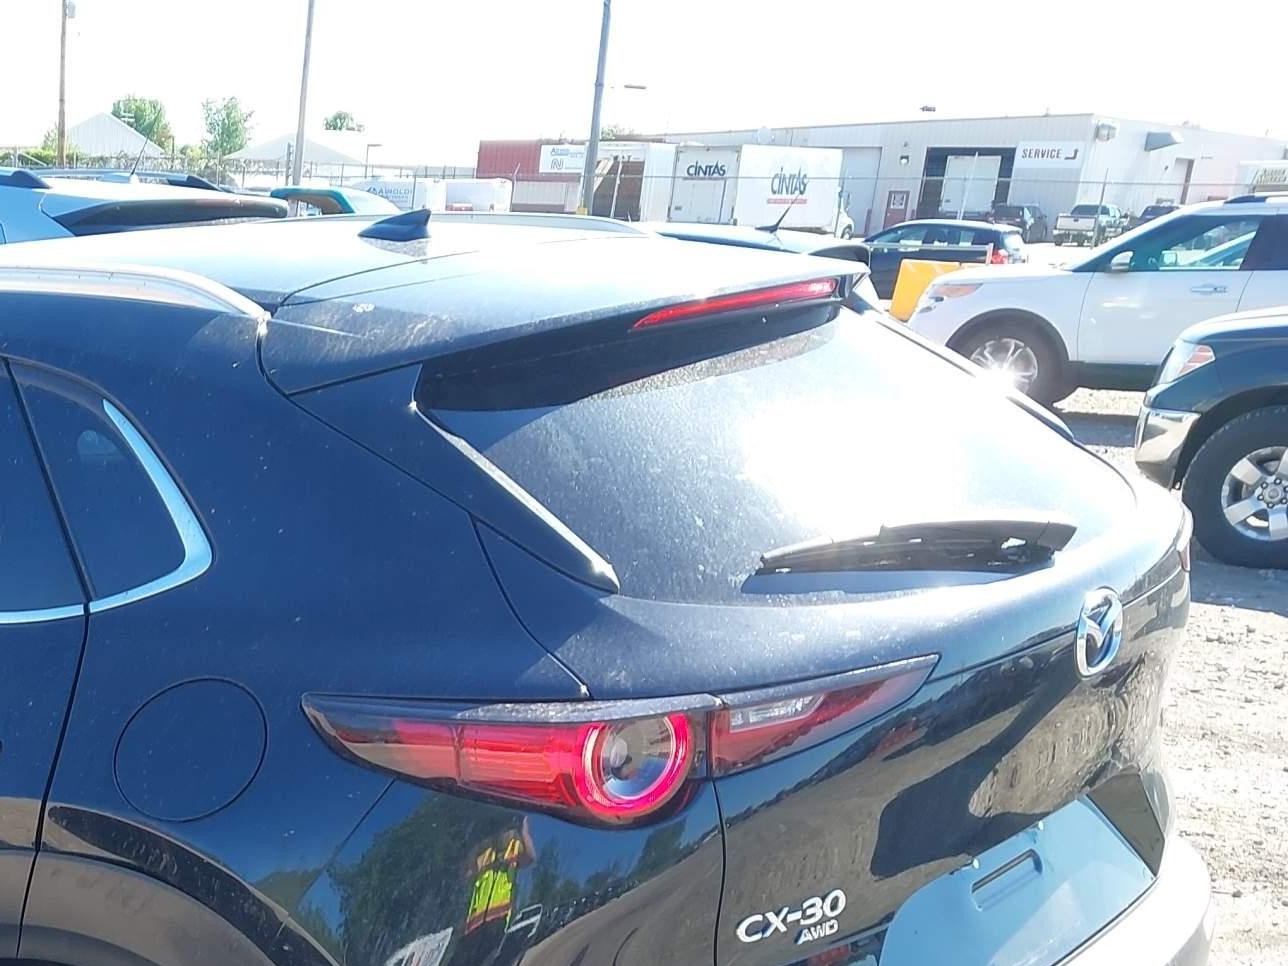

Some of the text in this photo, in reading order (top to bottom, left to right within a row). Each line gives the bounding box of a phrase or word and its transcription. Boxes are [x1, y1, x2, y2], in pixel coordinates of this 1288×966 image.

[1021, 148, 1062, 159] SERVICE
[735, 888, 847, 943] CX-30
[796, 919, 839, 945] AWD
